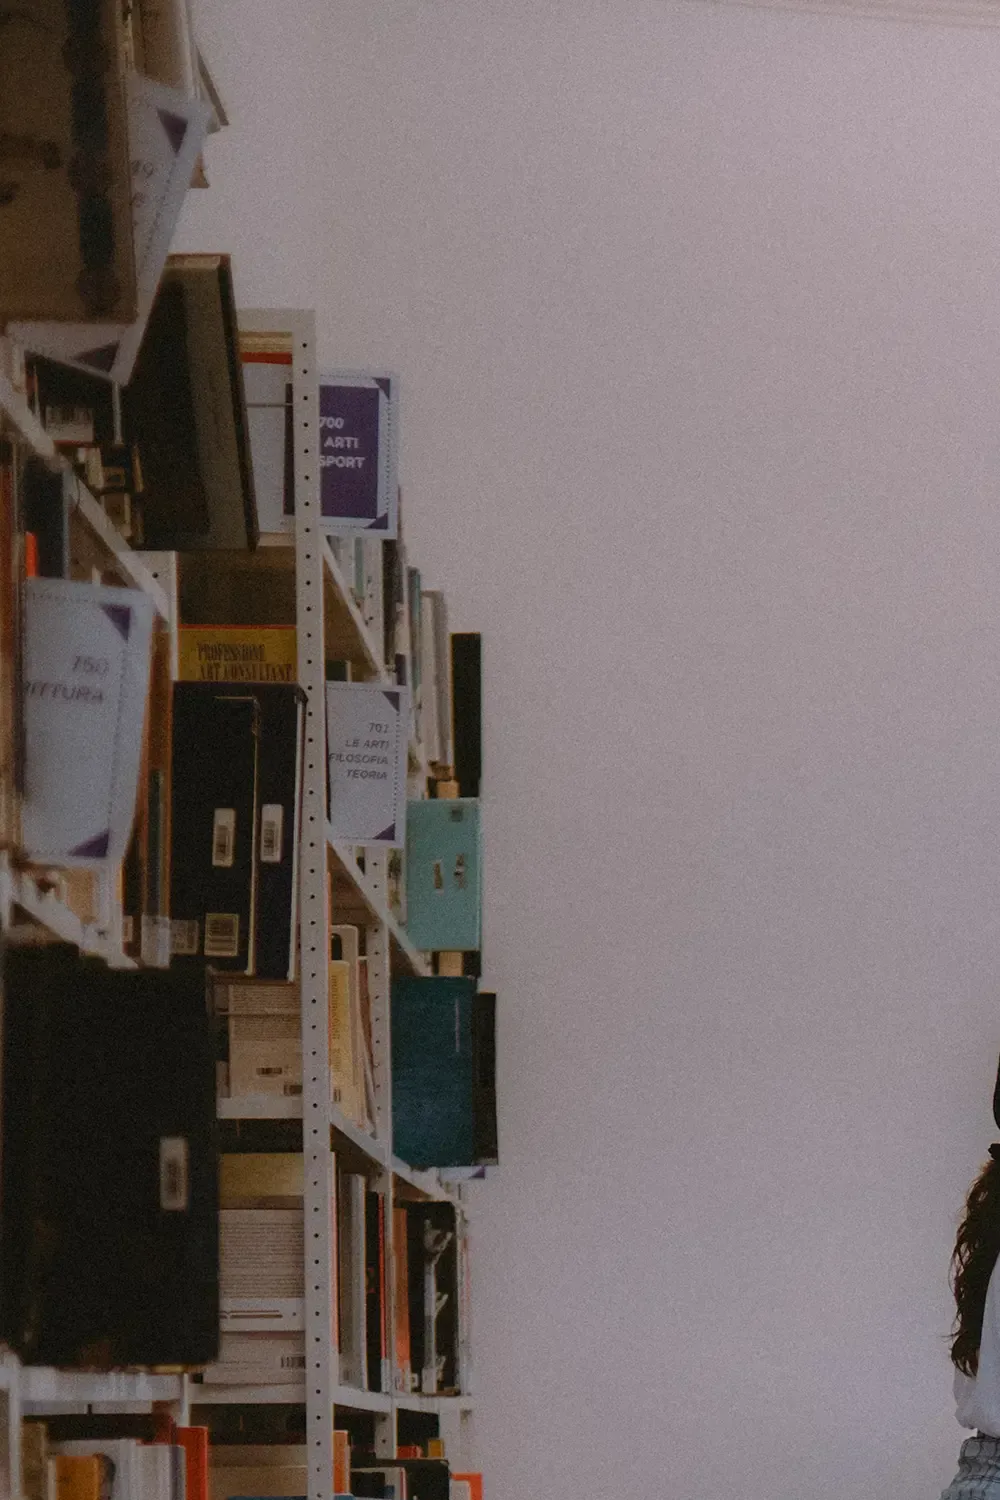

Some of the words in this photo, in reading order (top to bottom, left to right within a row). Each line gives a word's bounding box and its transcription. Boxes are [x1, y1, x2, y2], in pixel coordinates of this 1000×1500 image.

[323, 436, 359, 449] ARTI
[319, 455, 365, 469] SPORT
[344, 739, 359, 748] LE
[363, 739, 390, 750] ARTI
[329, 752, 389, 765] FILOSOFIA
[346, 769, 388, 780] TEORIA
